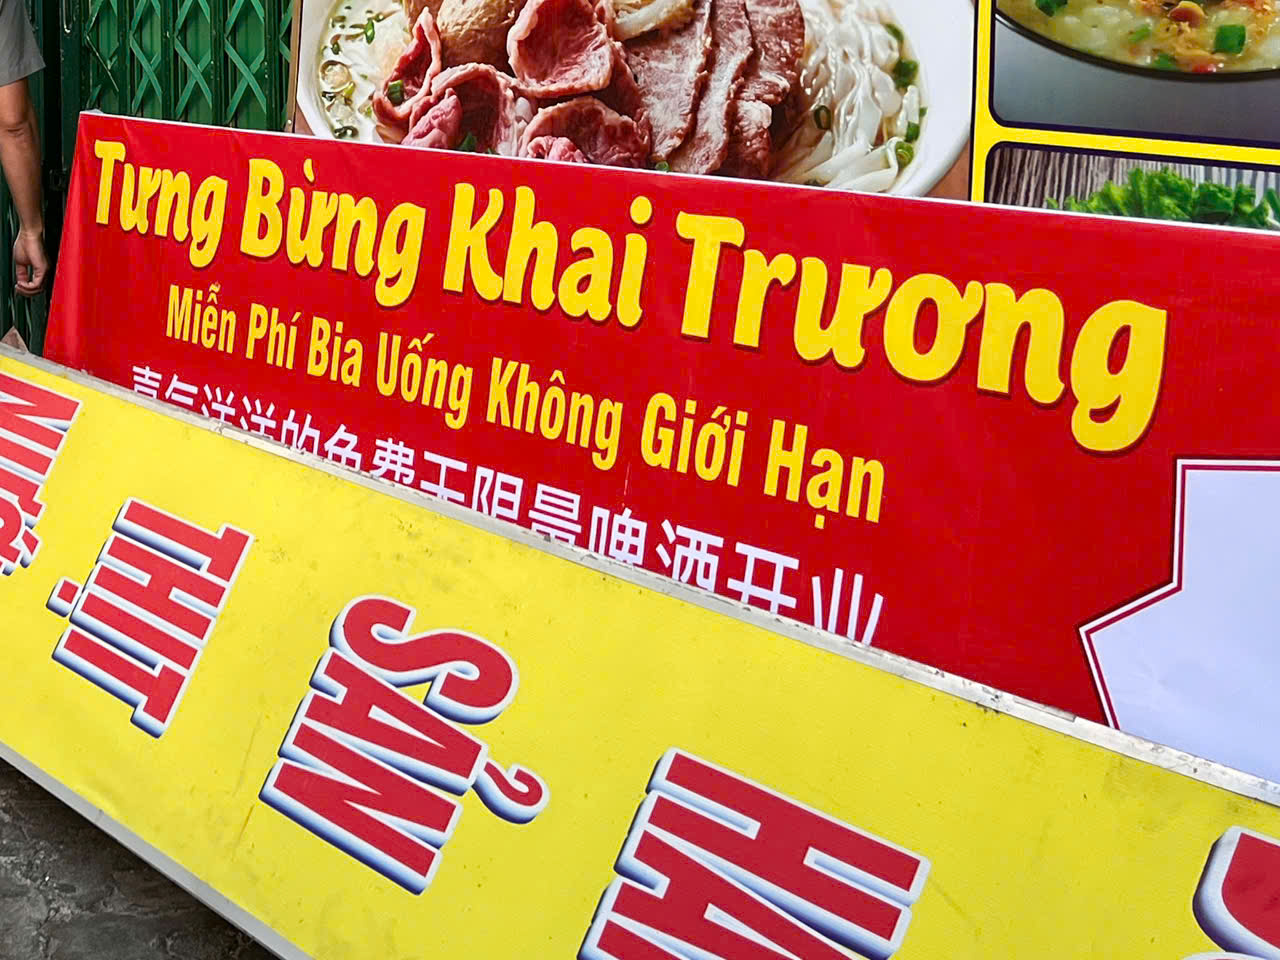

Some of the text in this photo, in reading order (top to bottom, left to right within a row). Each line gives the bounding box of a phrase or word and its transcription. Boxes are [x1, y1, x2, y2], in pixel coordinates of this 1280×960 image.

[93, 140, 1169, 453] Tưng Bừng Khai Trương
[167, 283, 886, 530] Miễn Phí Bia Uống Không Giới Hạn
[47, 496, 255, 739] THỊT
[260, 594, 550, 895] SẢN
